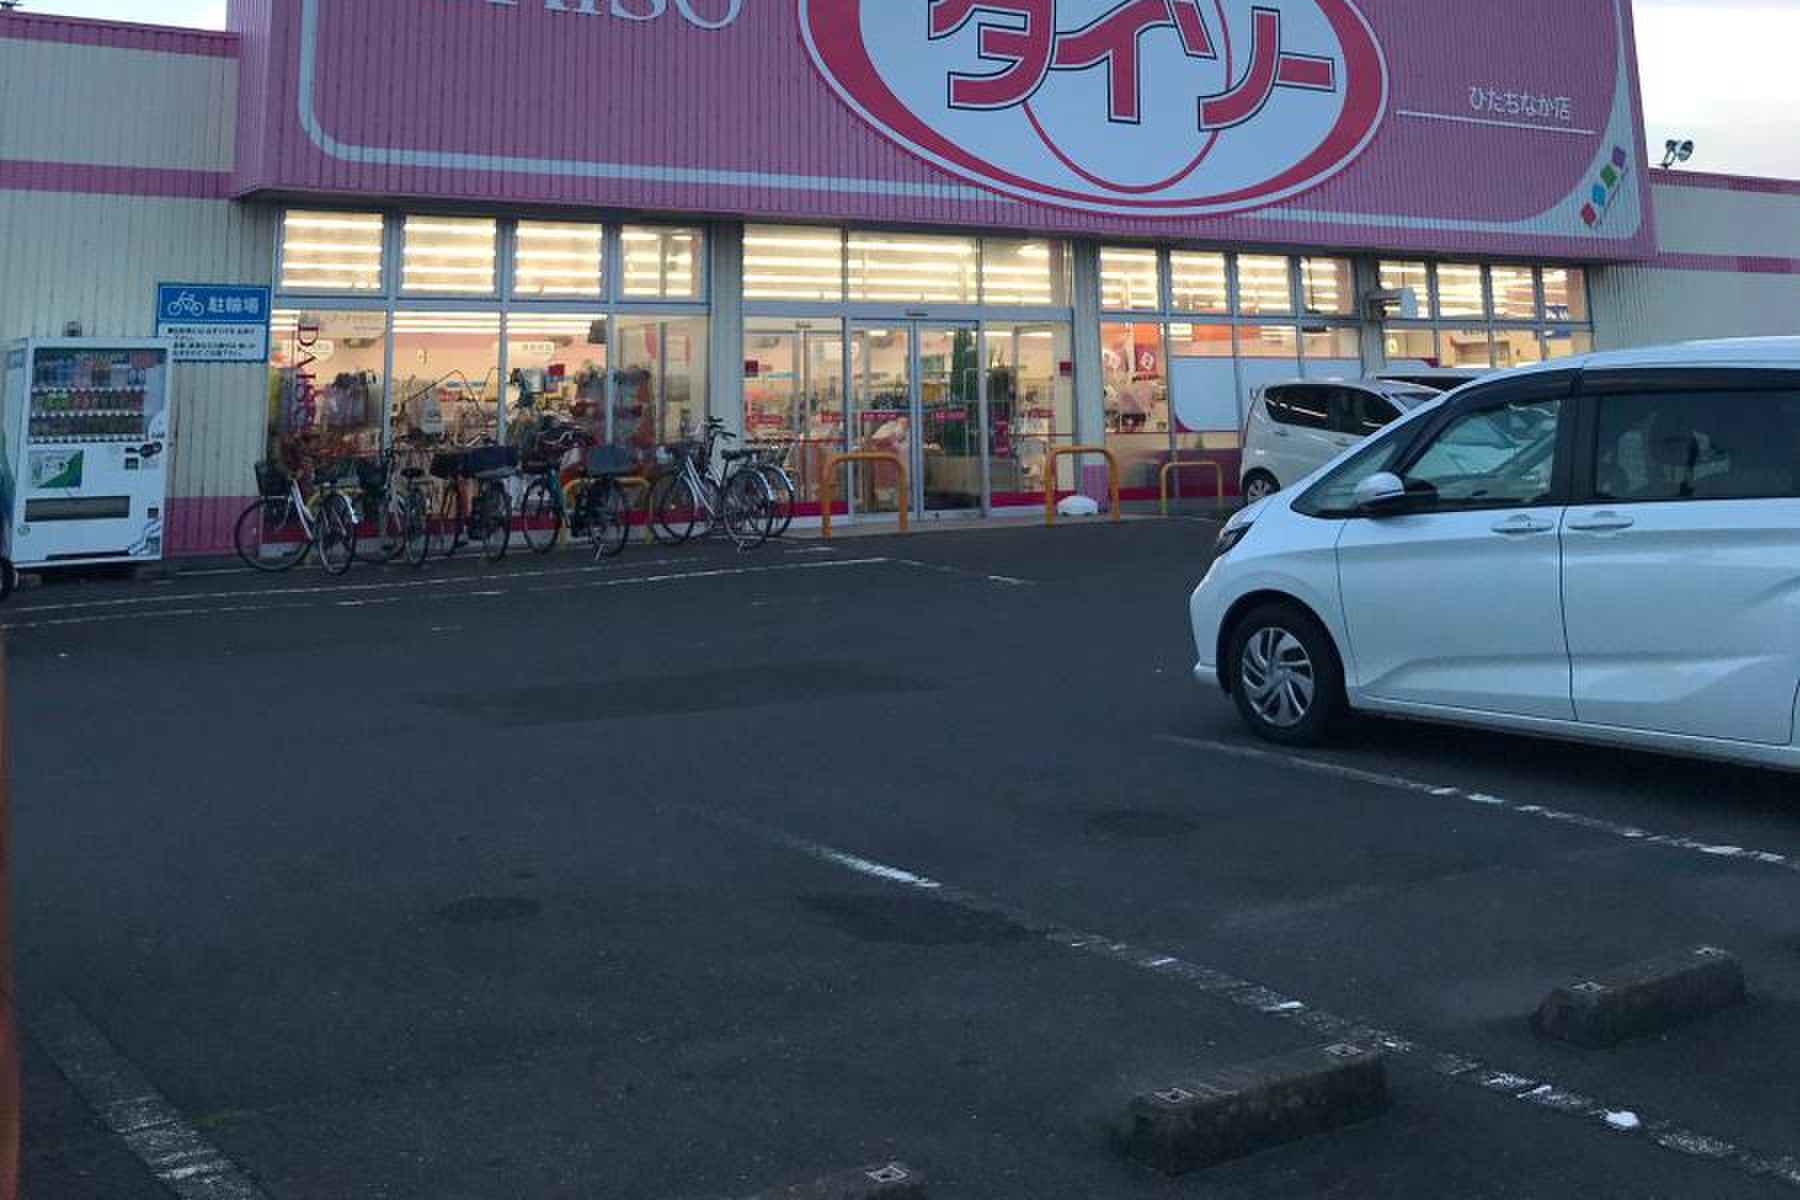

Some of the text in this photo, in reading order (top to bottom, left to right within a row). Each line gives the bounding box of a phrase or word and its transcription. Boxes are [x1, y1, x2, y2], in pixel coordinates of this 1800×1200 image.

[1470, 86, 1572, 122] ひたちなか店
[208, 296, 260, 315] 駐輪場
